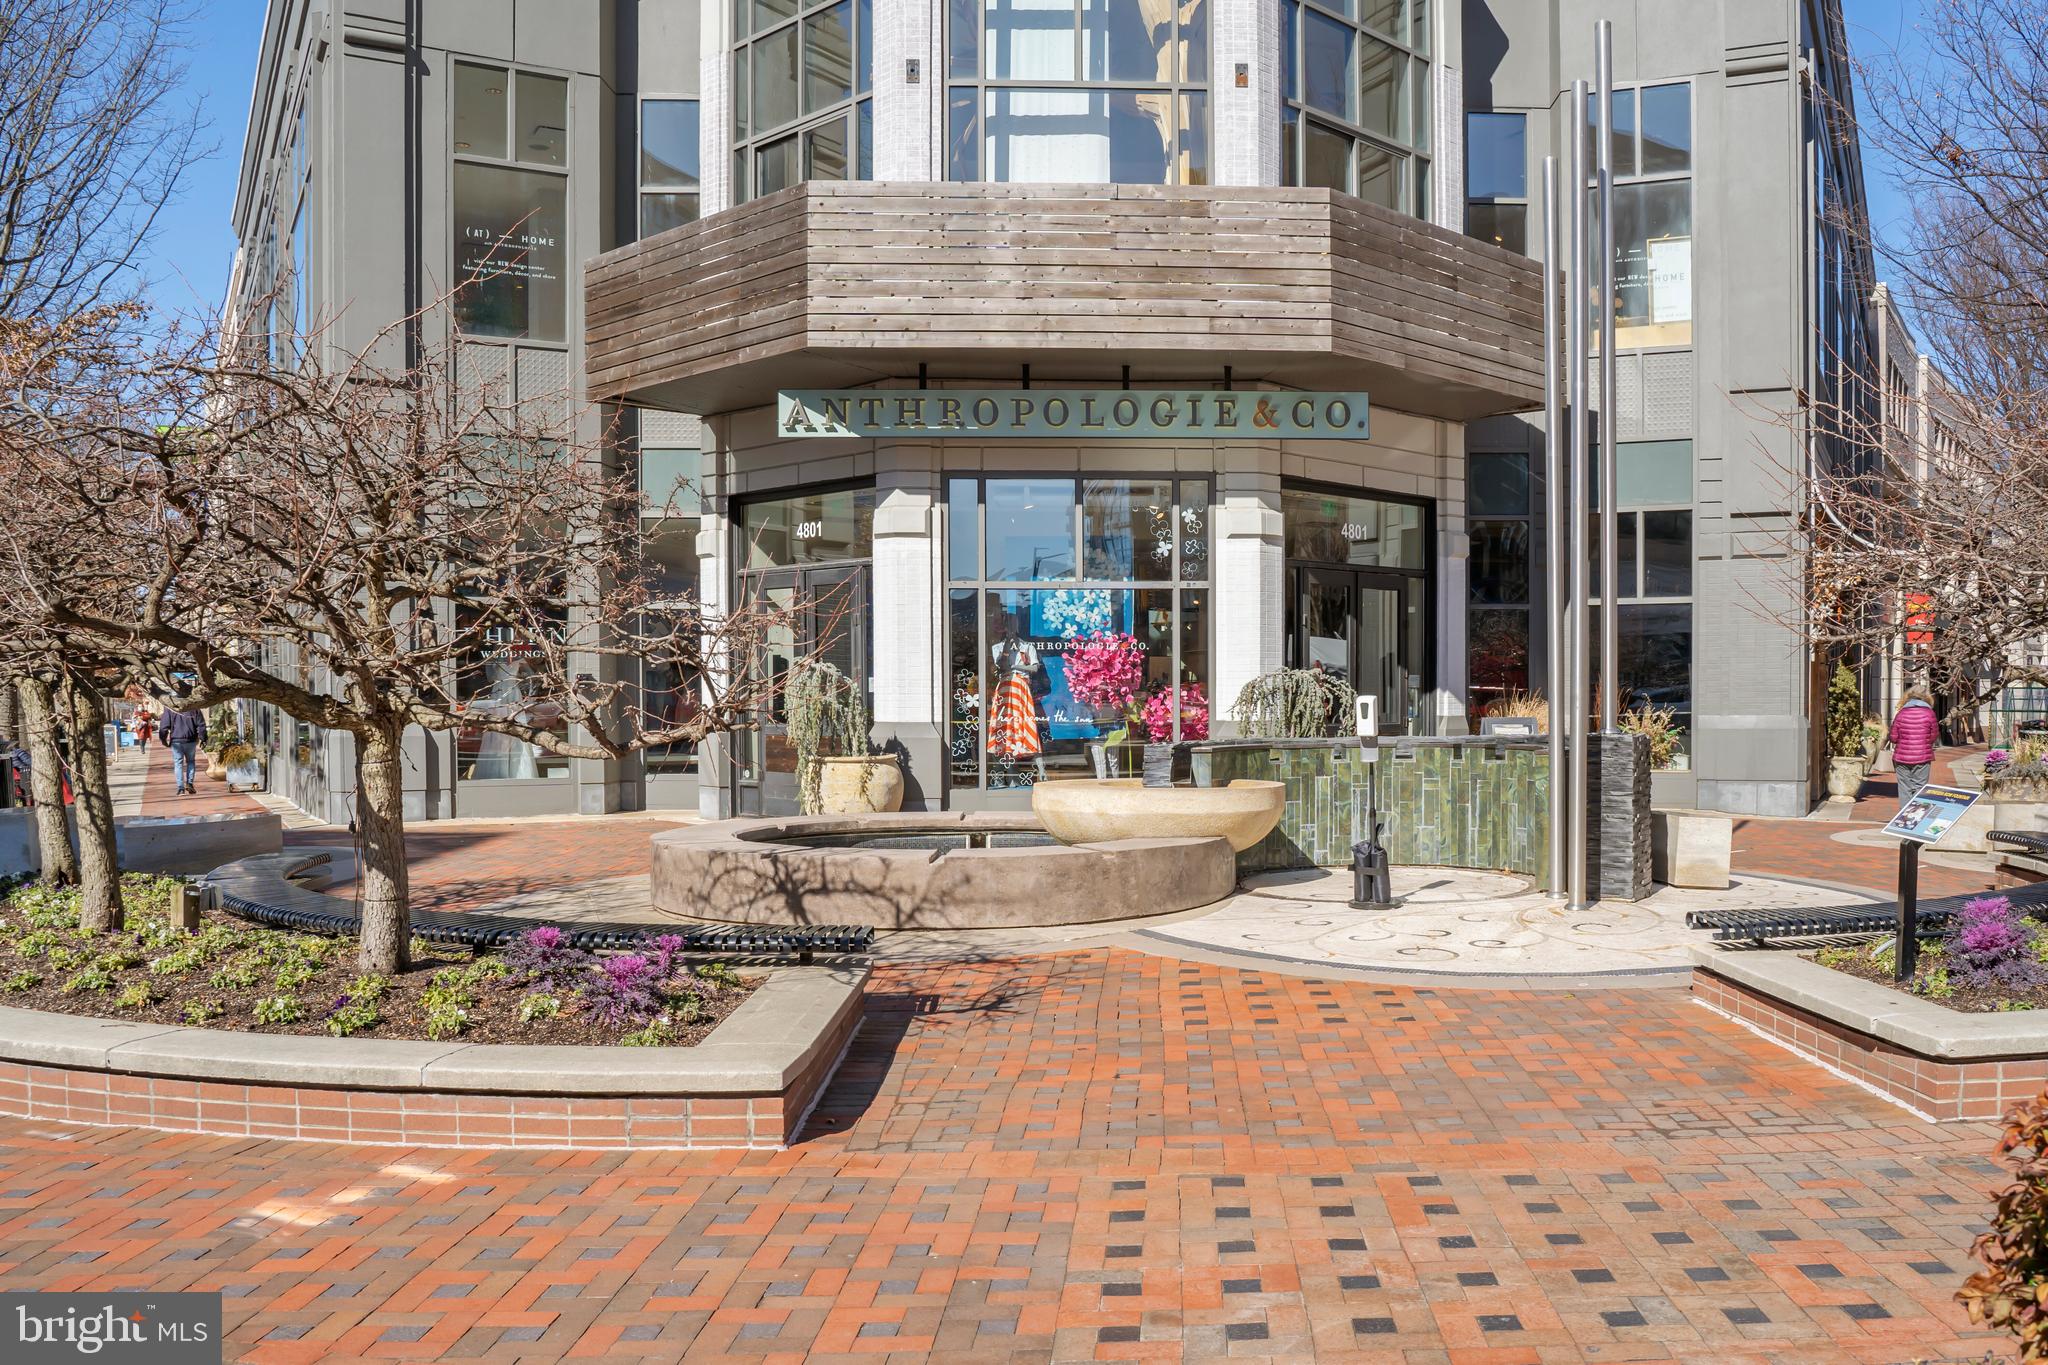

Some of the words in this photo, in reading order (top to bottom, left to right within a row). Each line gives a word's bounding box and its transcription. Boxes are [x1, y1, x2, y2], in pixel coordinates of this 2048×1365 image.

[521, 235, 555, 247] HOME
[797, 521, 822, 538] 4801
[1341, 523, 1367, 540] 4801
[1010, 642, 1118, 650] ATHROPOLOGIE
[1130, 642, 1149, 650] CO.
[1054, 710, 1070, 722] the
